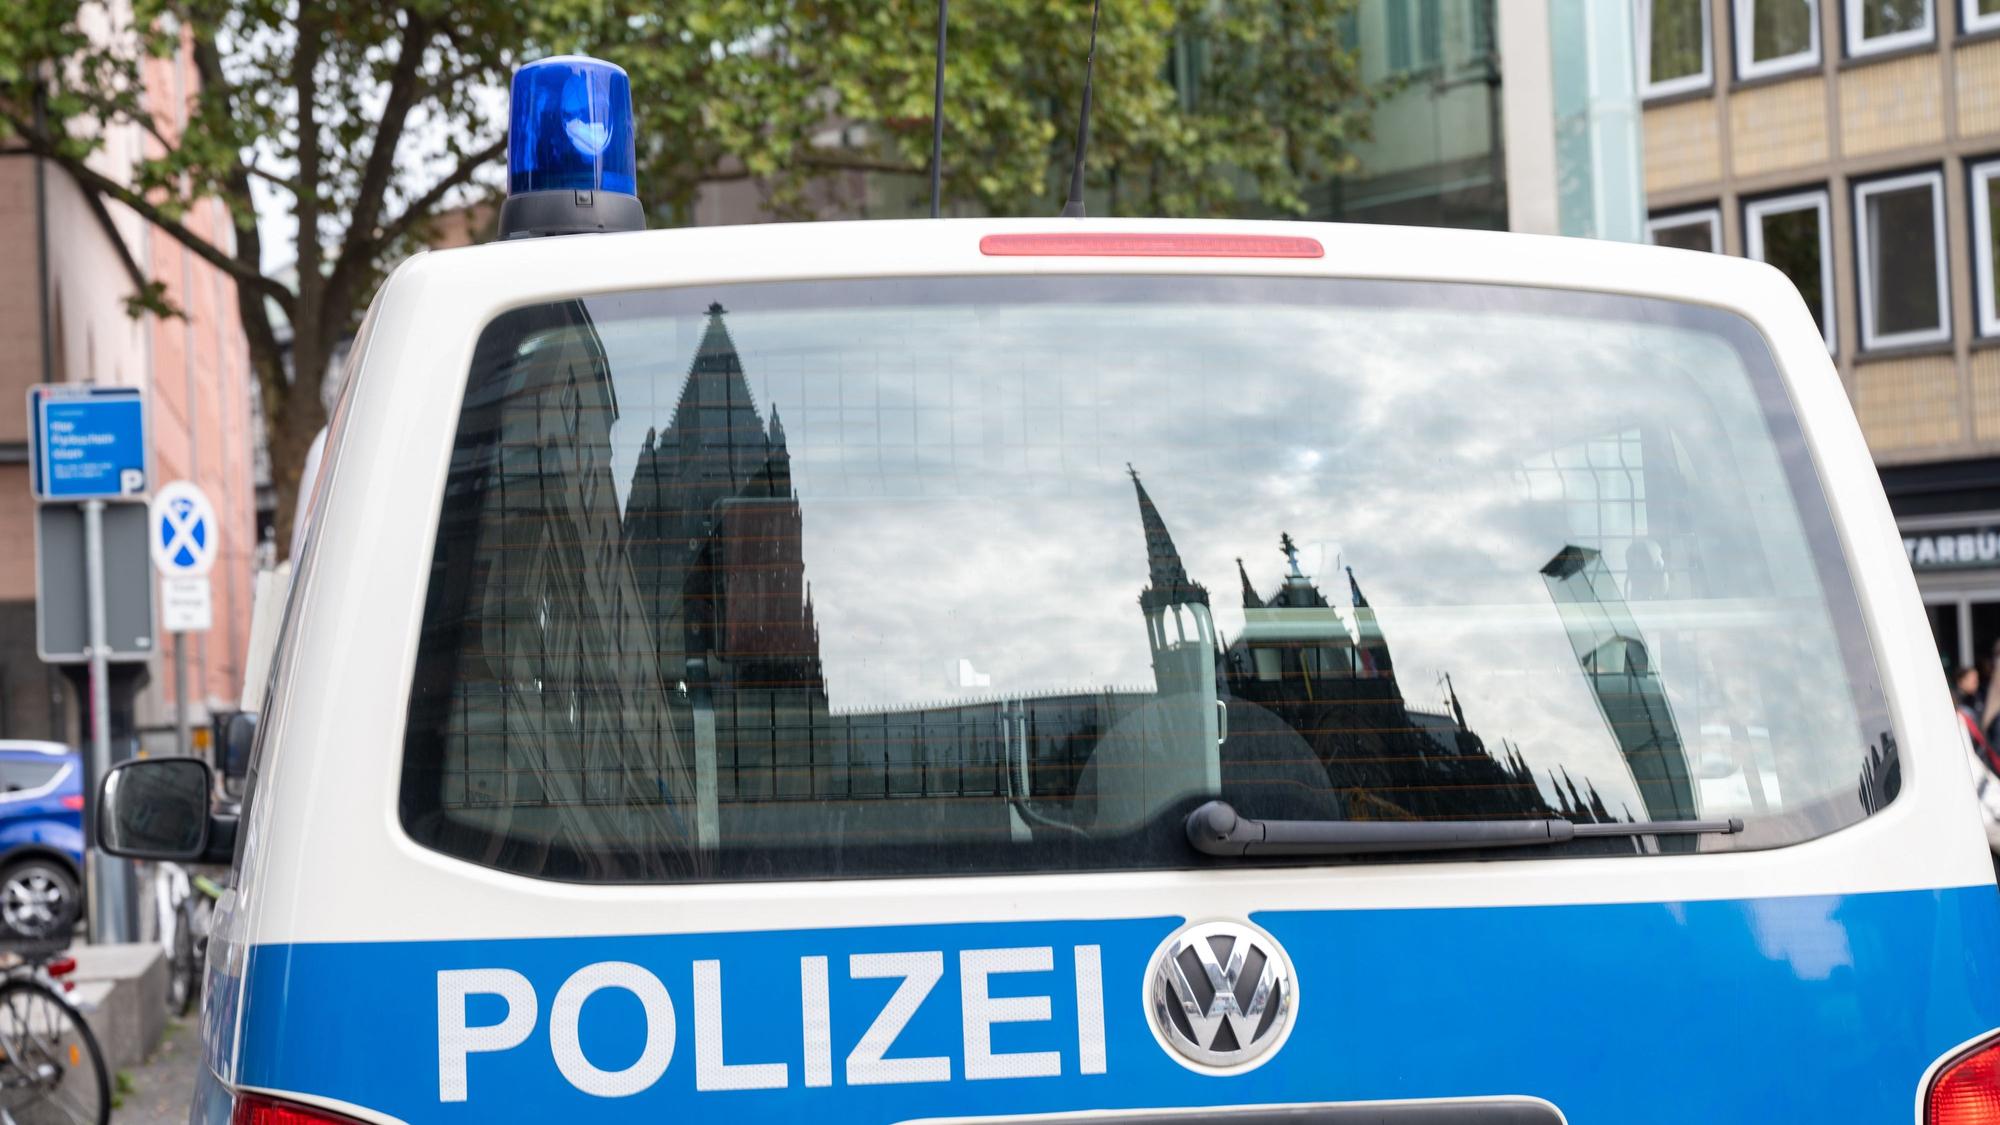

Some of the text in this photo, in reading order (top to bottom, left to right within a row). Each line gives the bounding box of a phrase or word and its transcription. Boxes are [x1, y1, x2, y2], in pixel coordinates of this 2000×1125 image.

[120, 468, 144, 497] P
[1902, 532, 2000, 564] TARBU
[437, 945, 1107, 1102] POLIZEI
[1154, 924, 1288, 1065] VW
